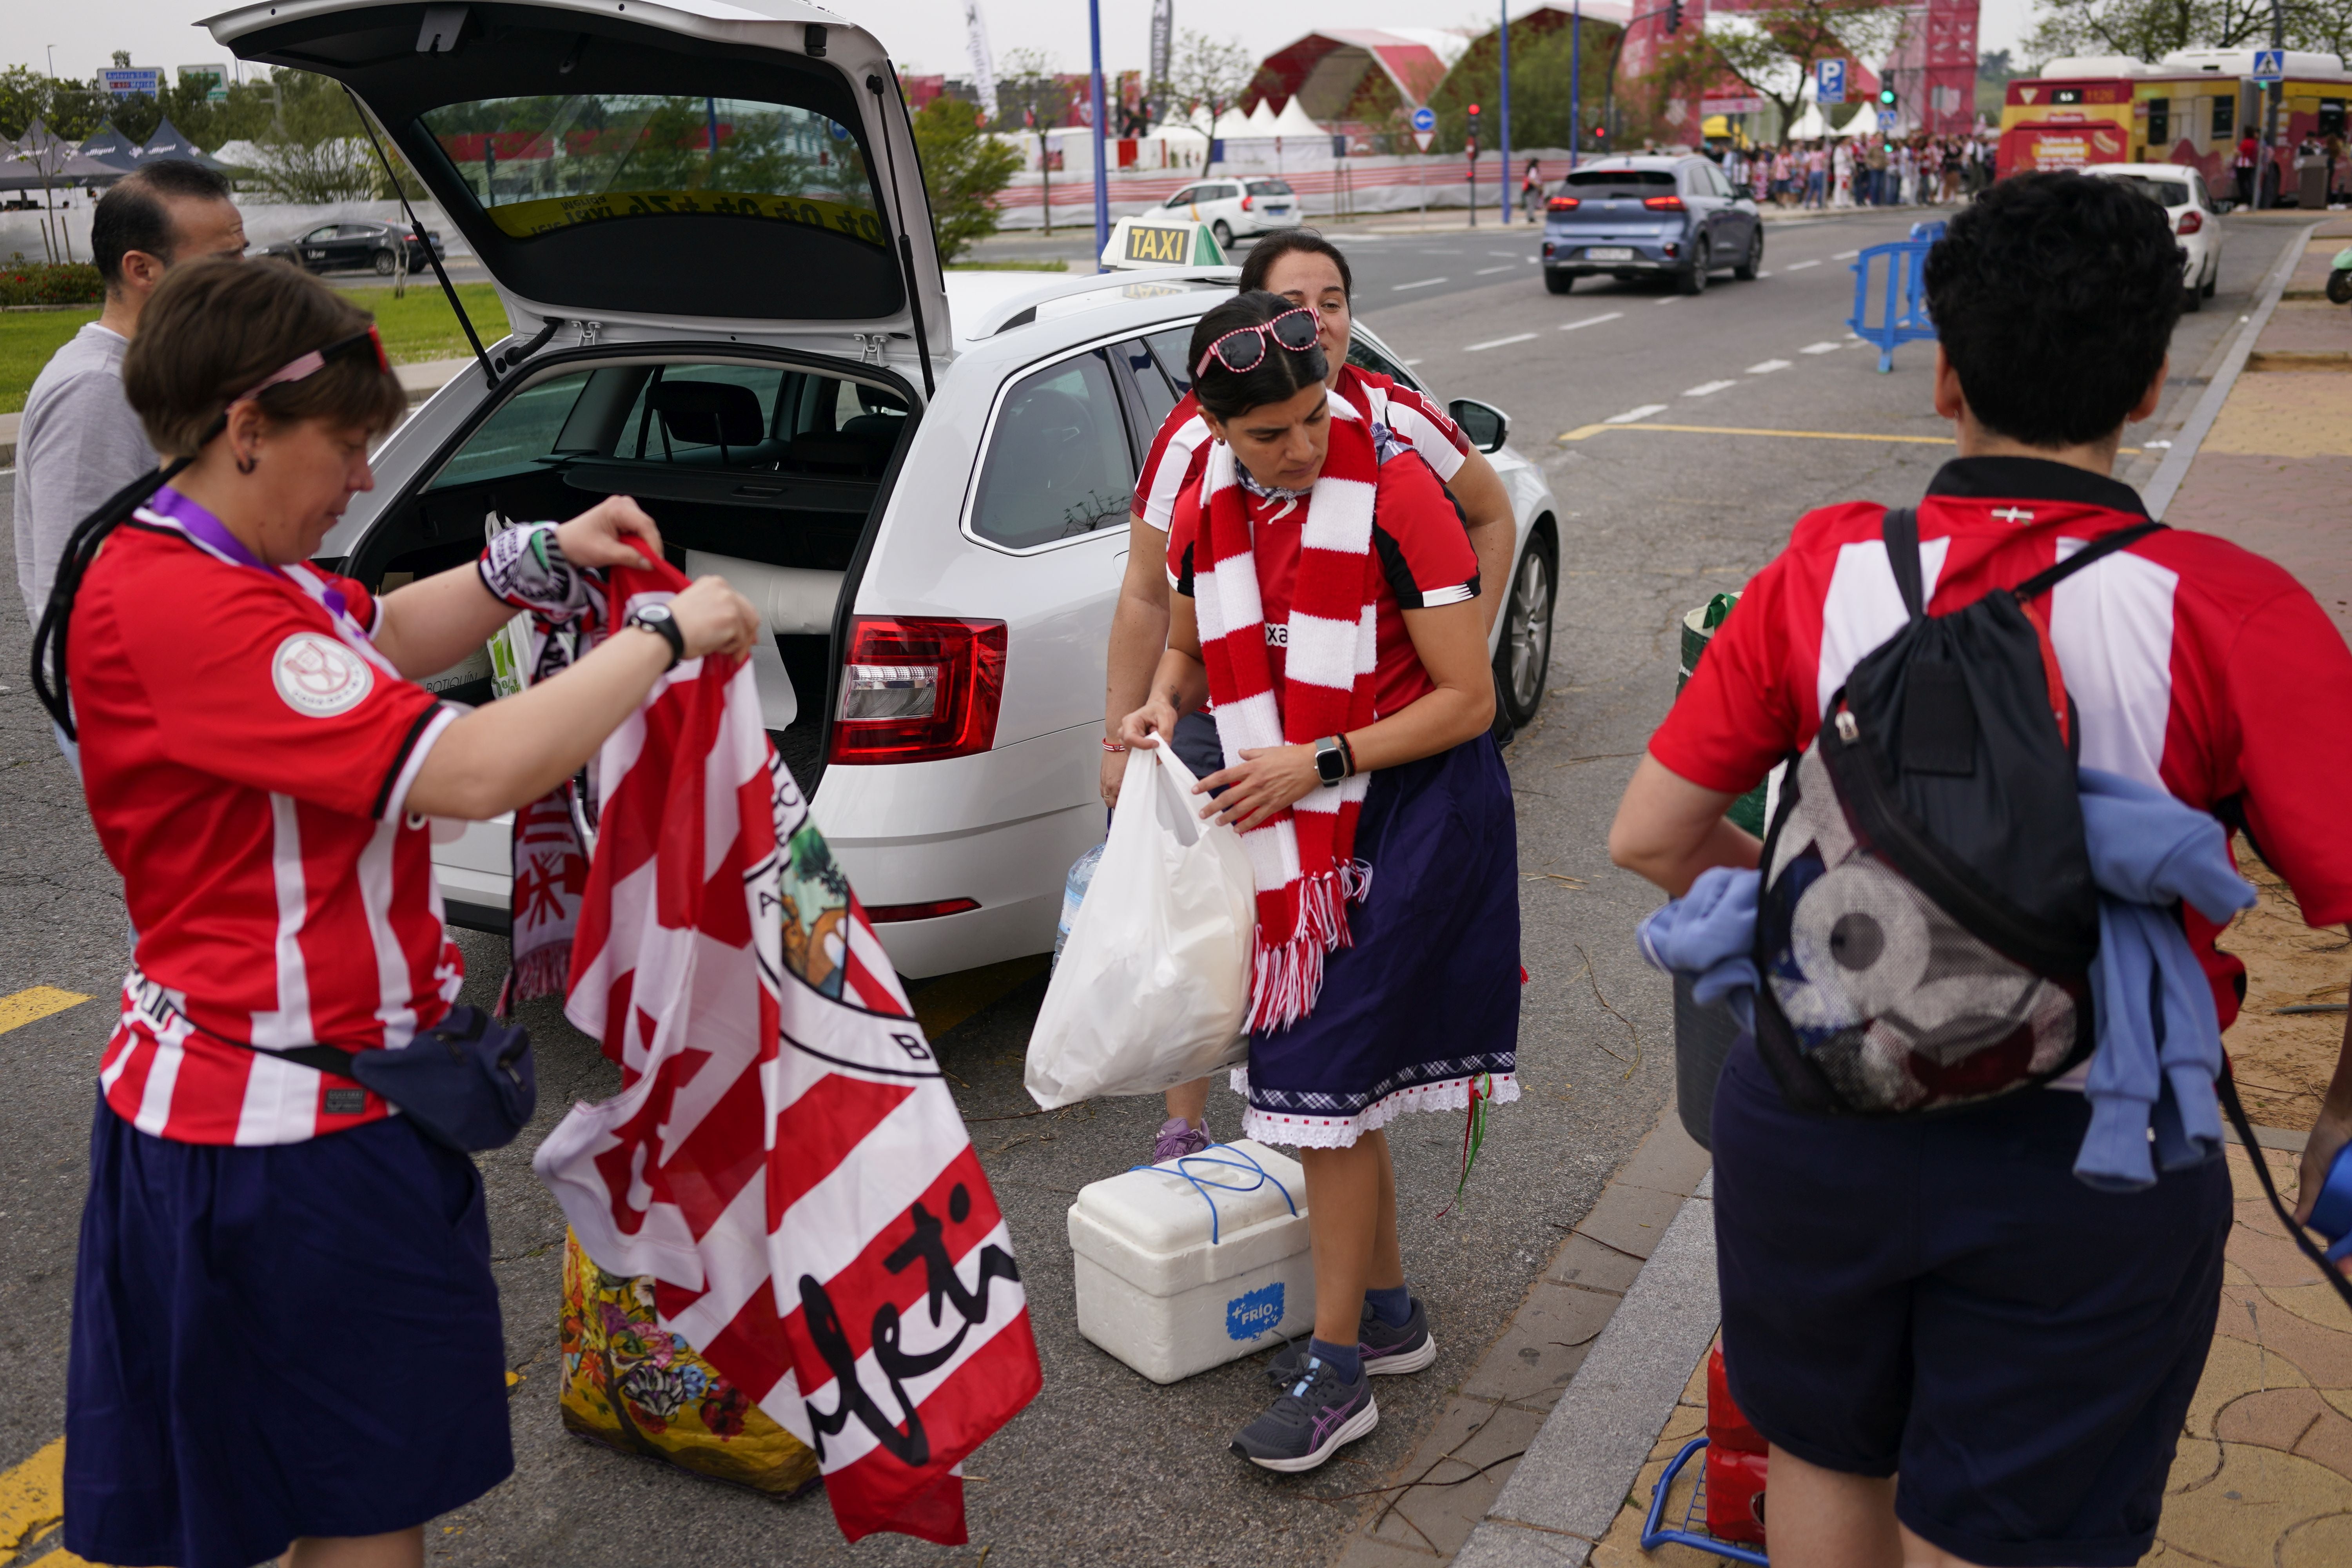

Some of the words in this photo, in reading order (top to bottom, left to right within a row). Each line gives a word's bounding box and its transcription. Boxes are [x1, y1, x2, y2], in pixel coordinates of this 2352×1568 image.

[1821, 62, 1841, 86] P
[308, 249, 326, 260] Uber
[1131, 229, 1184, 261] TAXI
[1267, 627, 1287, 644] xa
[426, 671, 477, 693] BOTIQUÍN
[1241, 1303, 1273, 1325] FRÍO
